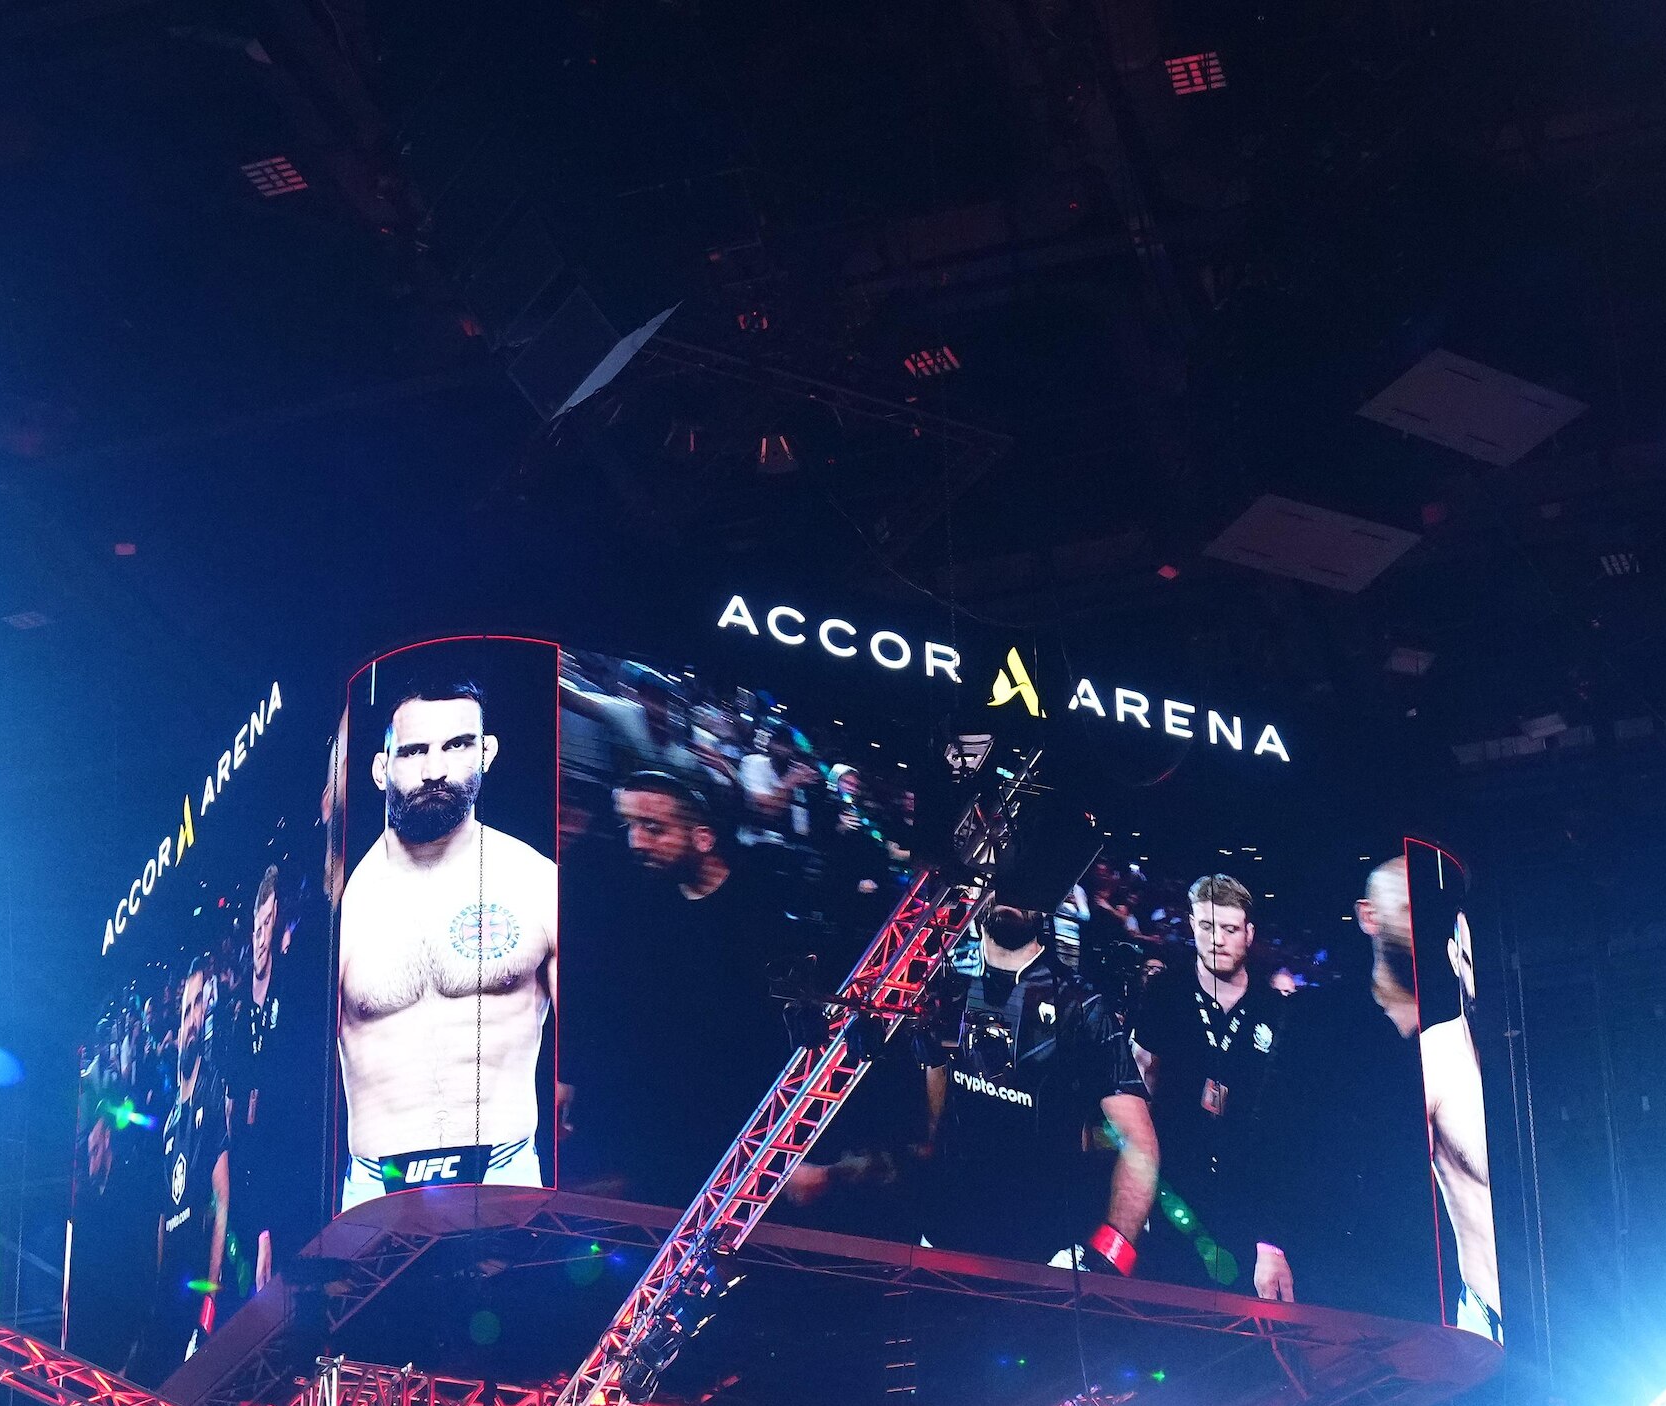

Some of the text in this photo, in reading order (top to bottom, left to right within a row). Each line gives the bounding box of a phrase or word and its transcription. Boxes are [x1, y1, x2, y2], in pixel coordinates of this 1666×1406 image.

[717, 594, 1292, 763] ACCOR ARENA
[101, 681, 282, 956] ACCOR ARENA
[953, 1068, 1033, 1108] crypto.com
[405, 1155, 461, 1183] UFC
